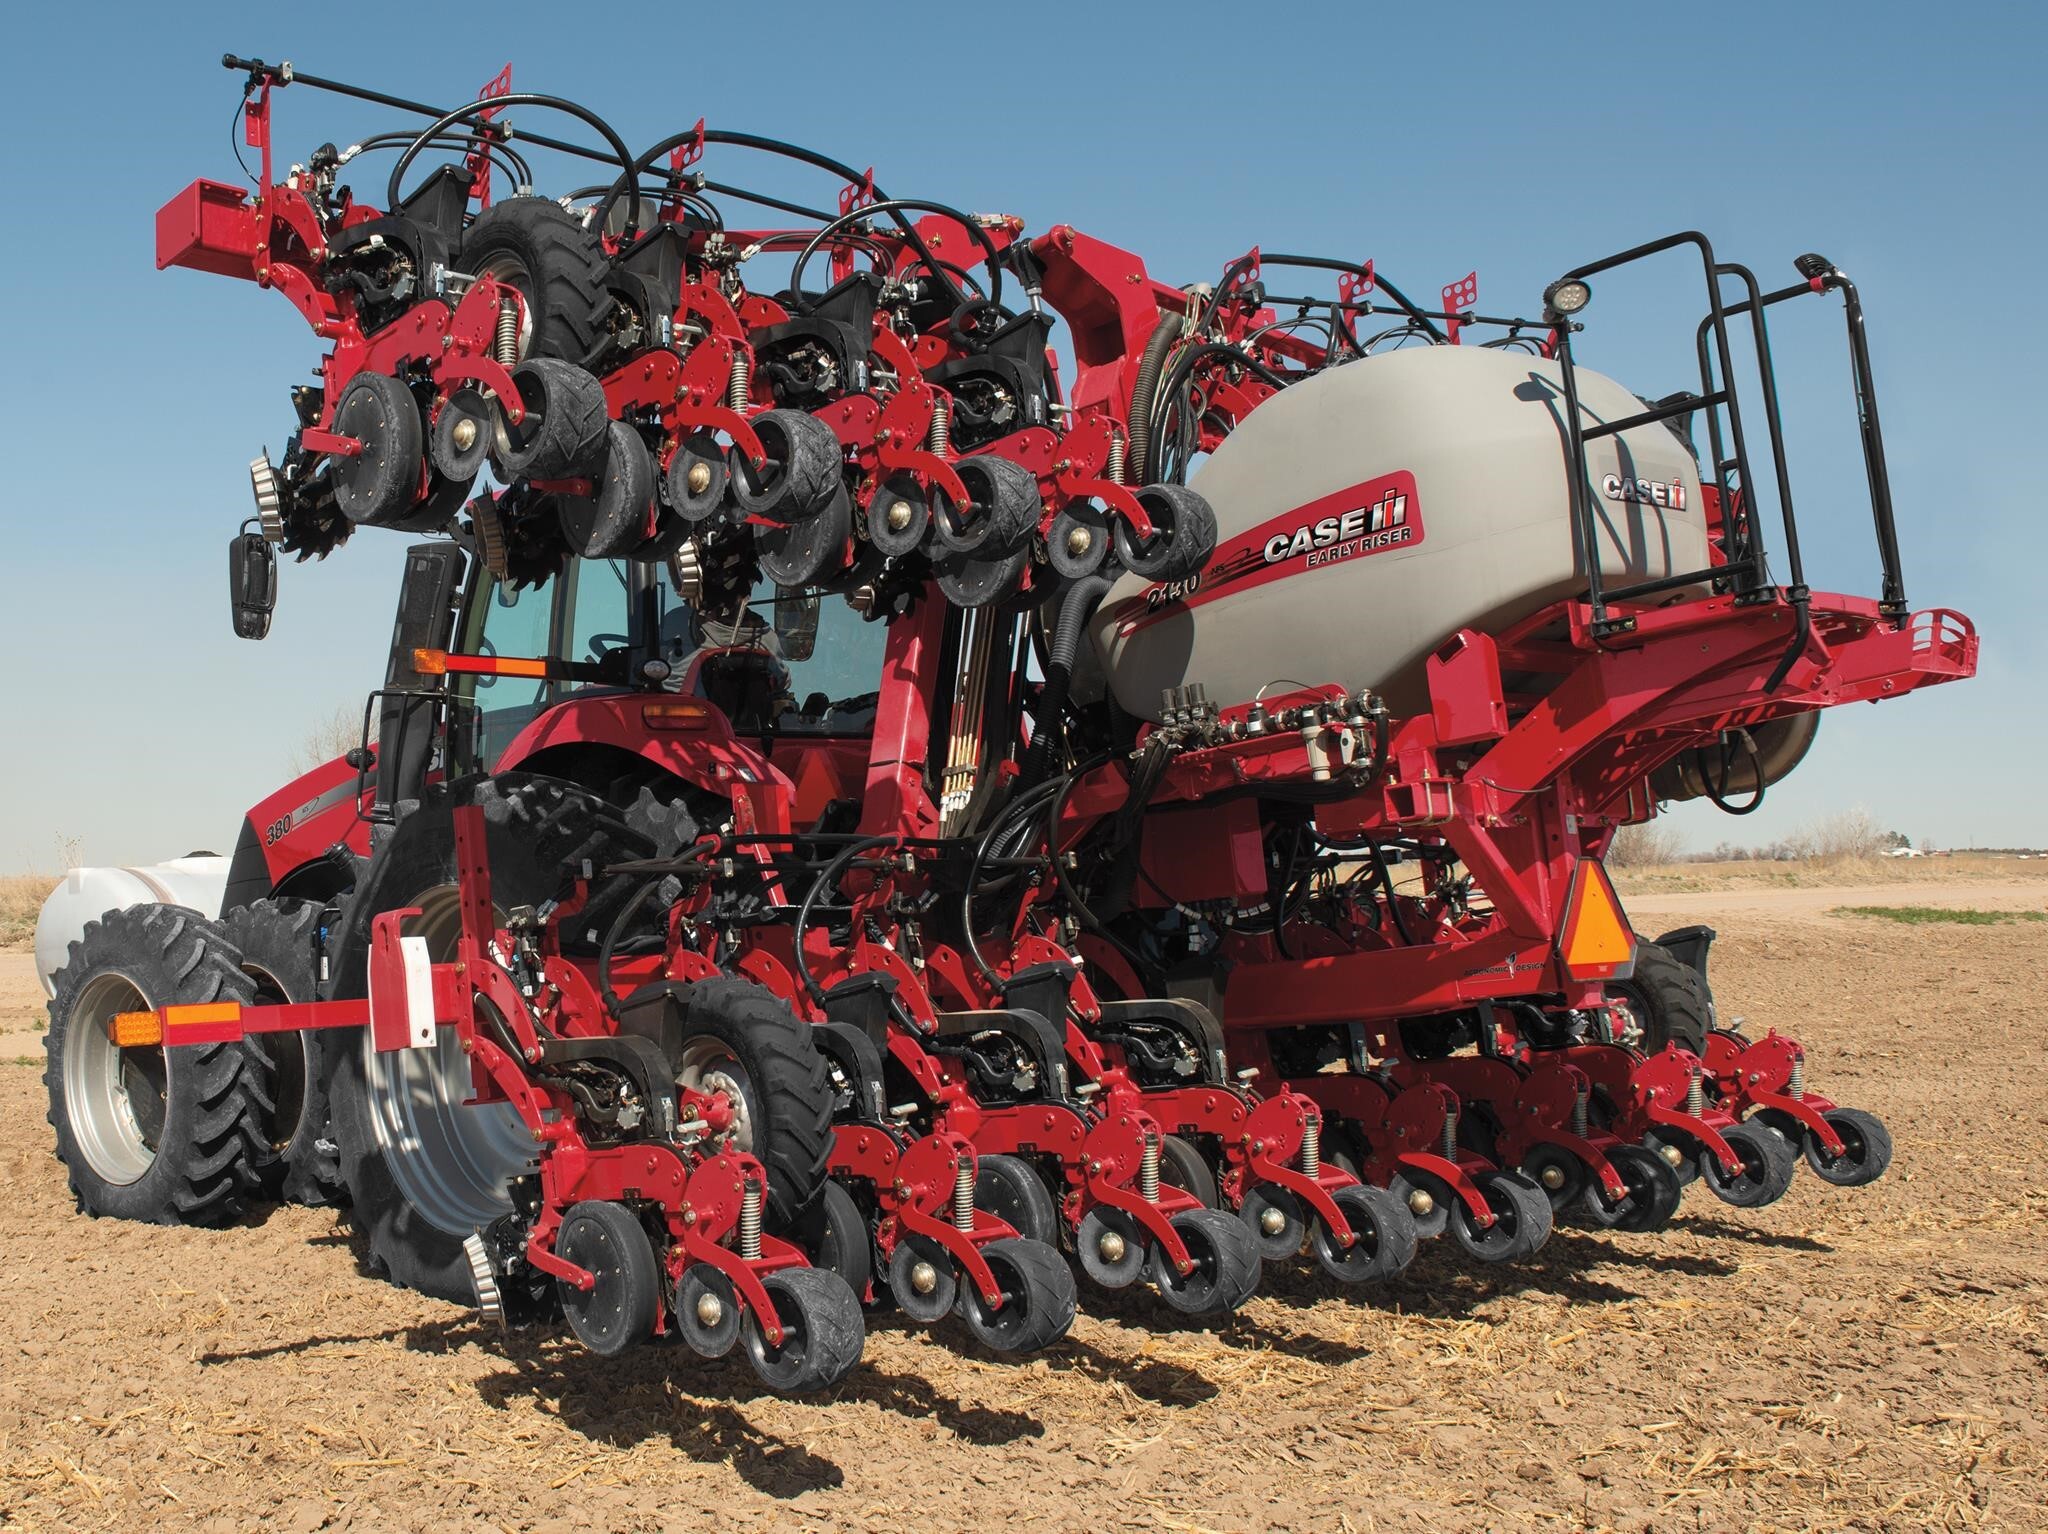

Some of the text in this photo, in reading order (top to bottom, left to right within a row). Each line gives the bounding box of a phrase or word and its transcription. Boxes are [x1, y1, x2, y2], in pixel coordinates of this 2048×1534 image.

[1602, 473, 1666, 506] CASE
[1263, 506, 1366, 563] CASE
[1306, 526, 1412, 567] EARLY RISER
[266, 812, 292, 847] 380
[1515, 962, 1546, 972] DESIGN
